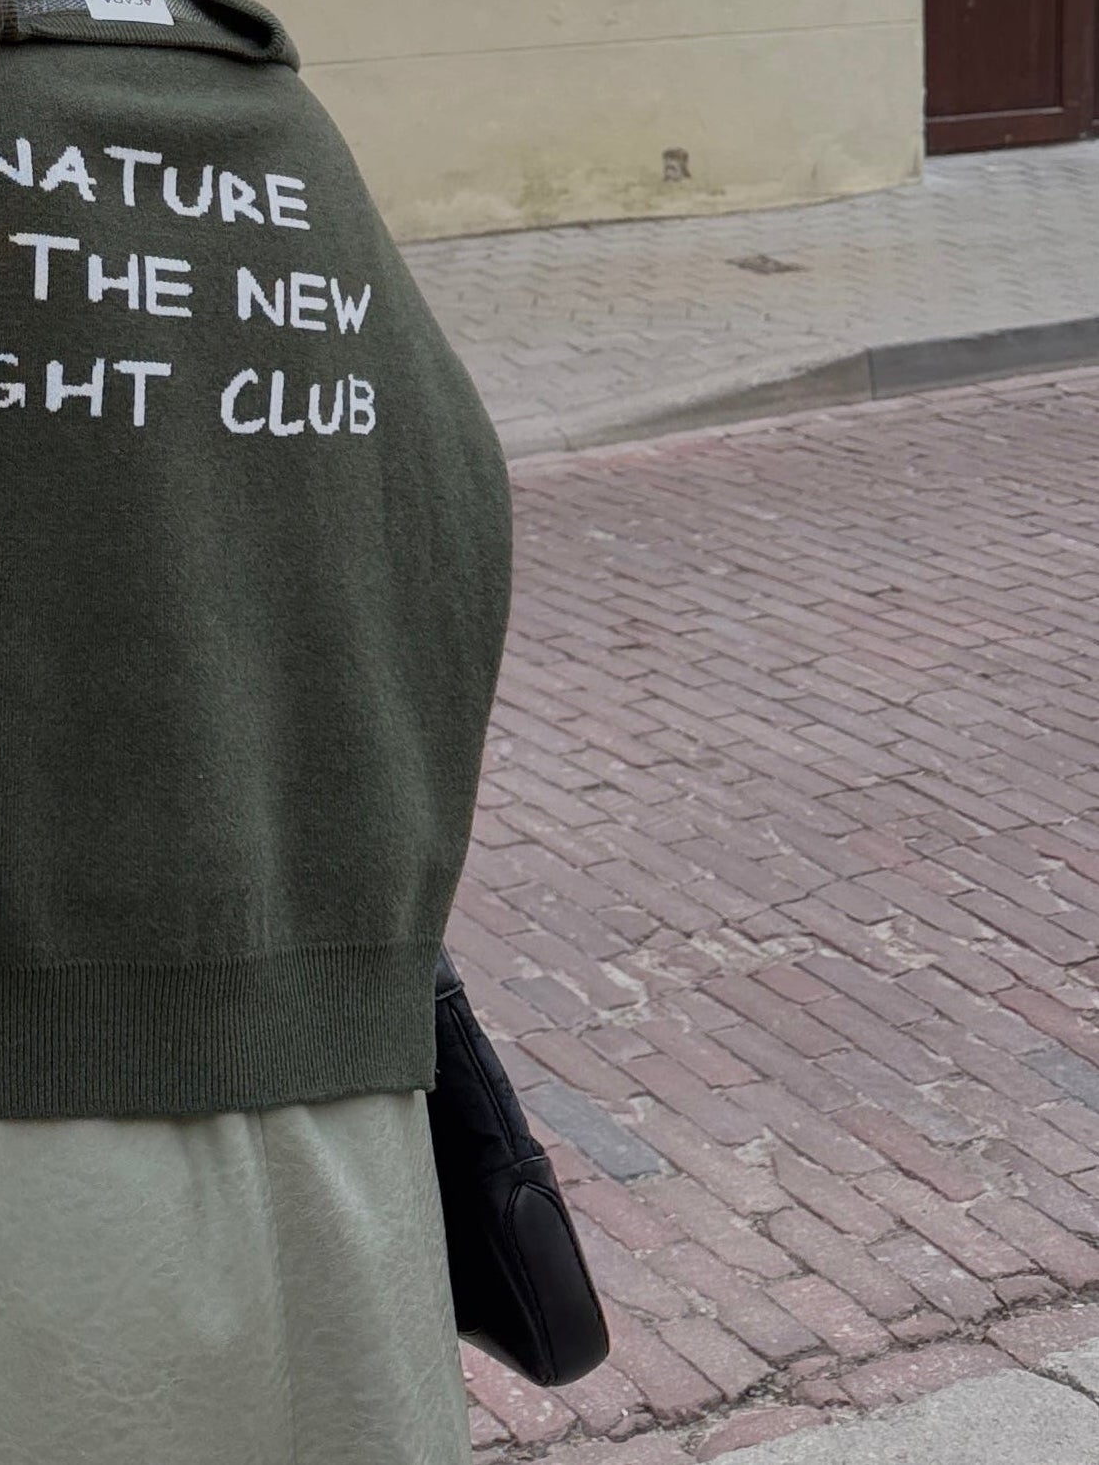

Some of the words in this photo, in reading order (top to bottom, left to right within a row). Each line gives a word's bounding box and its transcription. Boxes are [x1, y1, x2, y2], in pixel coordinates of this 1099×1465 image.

[8, 232, 193, 318] THE
[236, 266, 372, 335] NEW
[220, 367, 377, 437] CLUB
